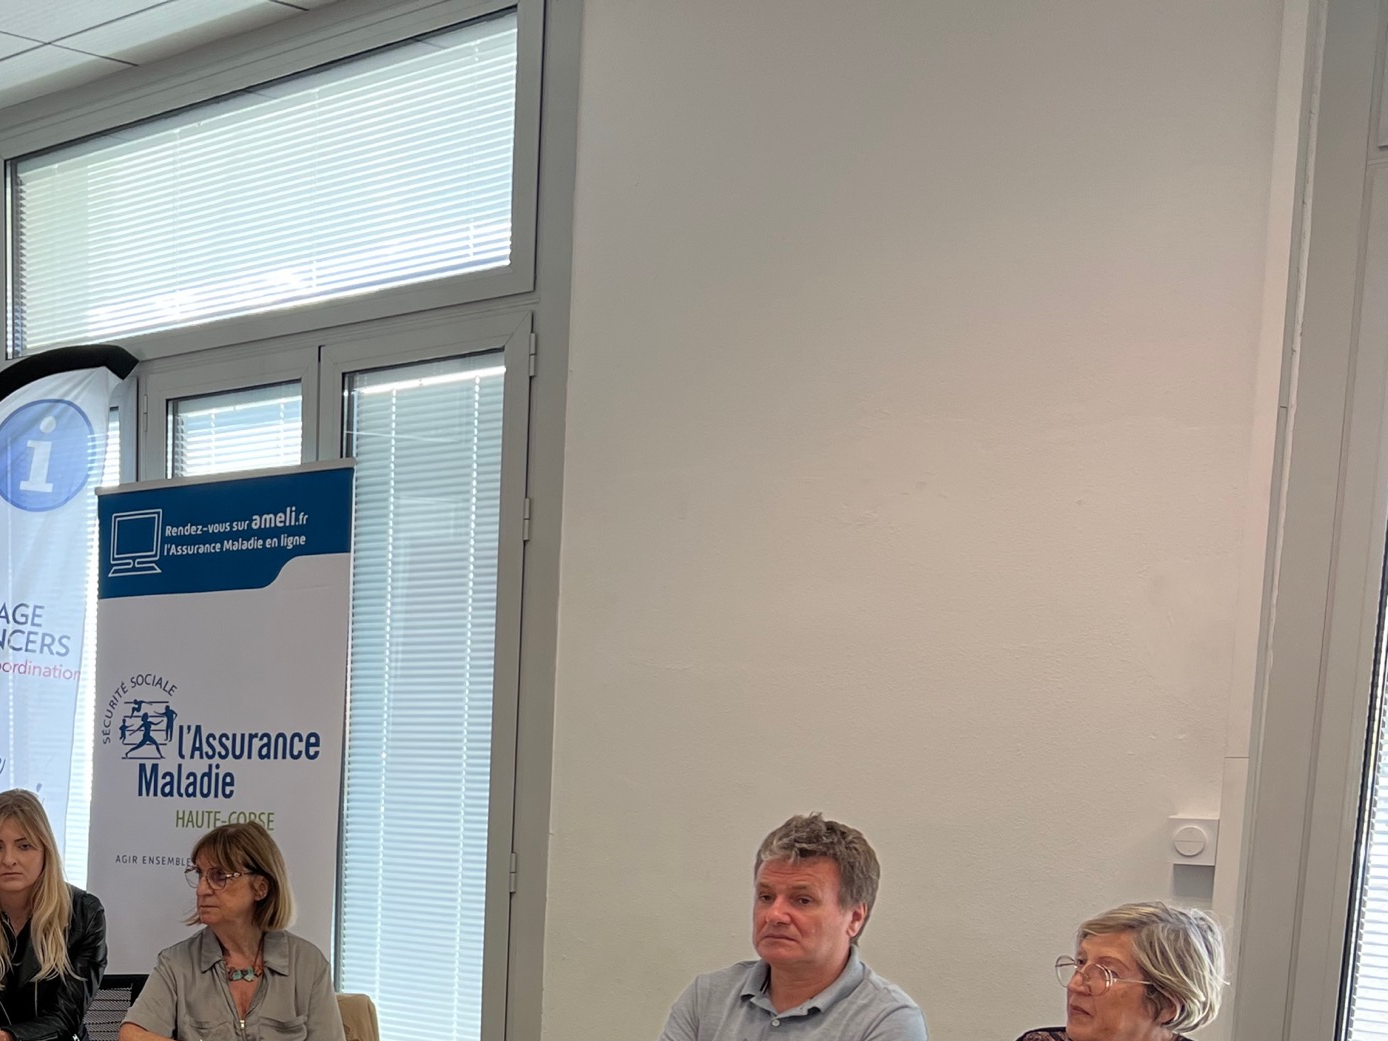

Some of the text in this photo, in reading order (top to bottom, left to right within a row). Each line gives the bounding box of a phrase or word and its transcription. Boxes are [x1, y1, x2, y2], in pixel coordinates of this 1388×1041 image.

[165, 506, 308, 536] Rendez-vous sur ameli.fr
[164, 534, 306, 556] l'Assurance Maladie en ligne
[102, 674, 178, 744] SÉCURITÉ SOCIALE
[178, 725, 320, 760] l'Assurance
[138, 763, 235, 799] Maladie
[115, 855, 138, 864] AGIR
